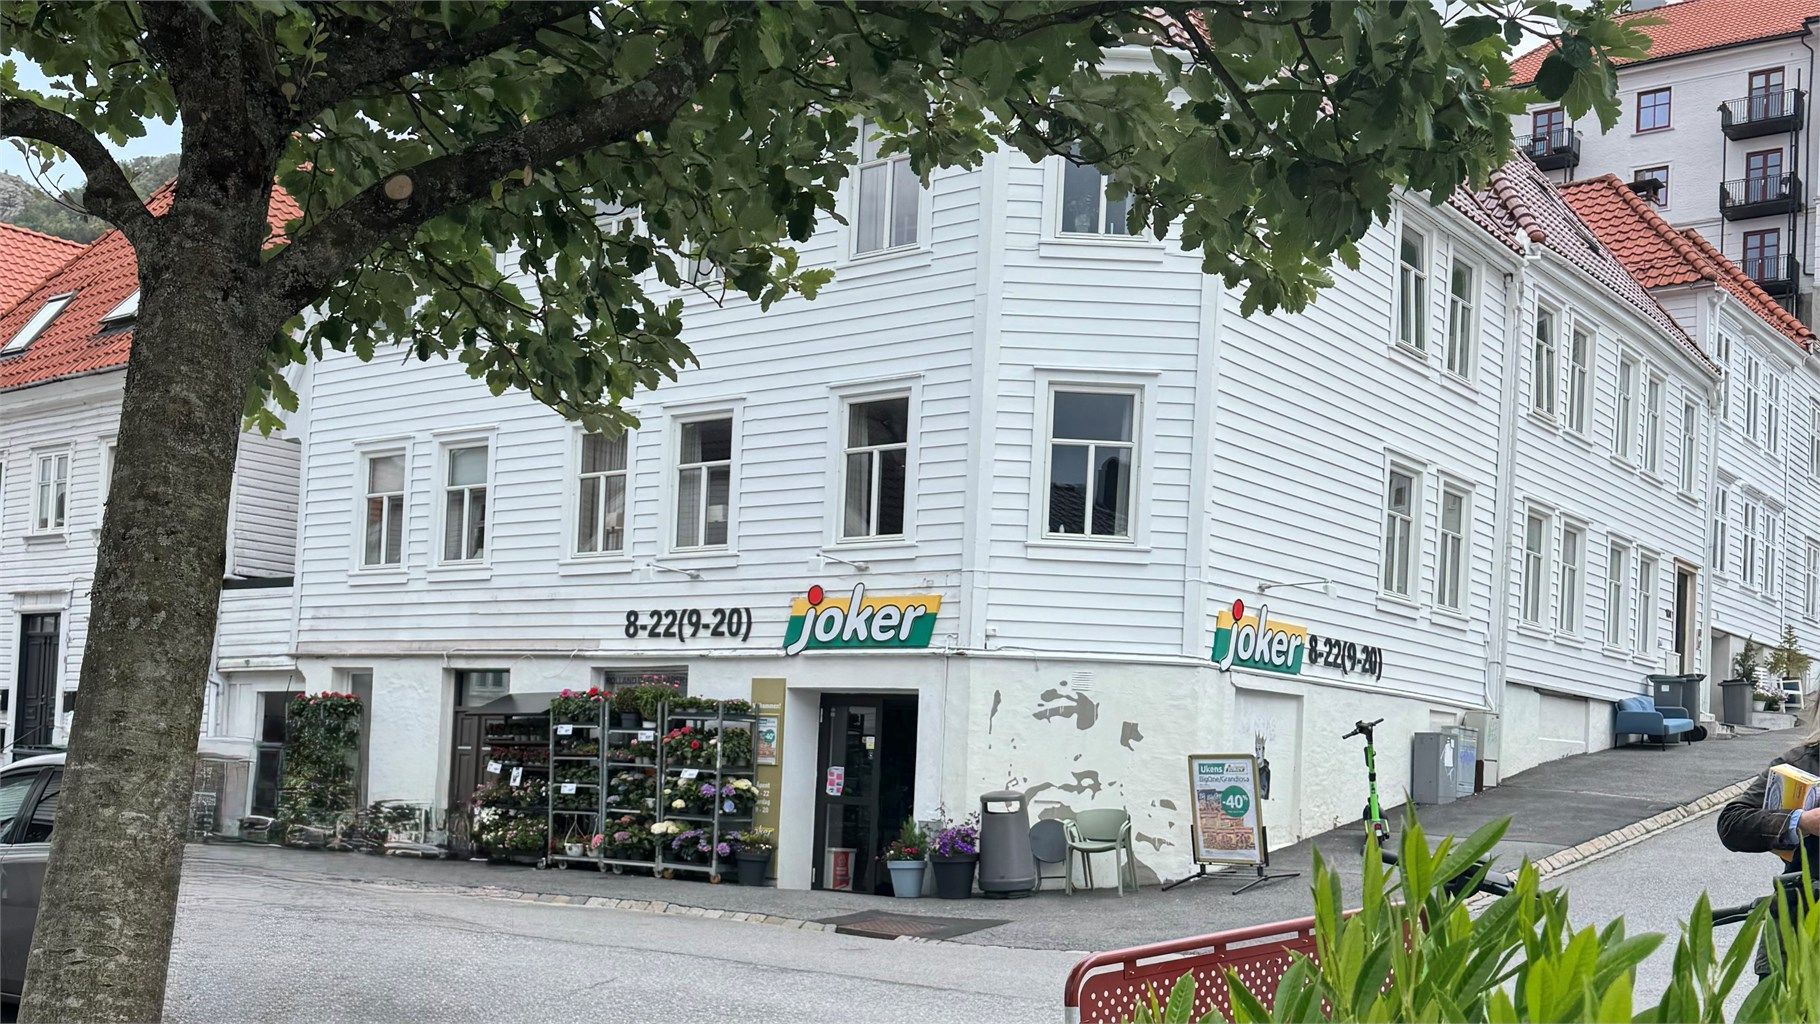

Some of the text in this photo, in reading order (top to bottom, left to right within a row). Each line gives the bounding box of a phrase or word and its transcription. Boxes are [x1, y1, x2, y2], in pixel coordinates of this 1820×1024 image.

[624, 607, 752, 643] 8-22(9-20)
[784, 582, 928, 656] joker
[1219, 599, 1303, 673] joker
[1308, 634, 1383, 682] 8-22(9-20)
[1200, 765, 1223, 773] Ukens
[1222, 794, 1248, 809] -40%
